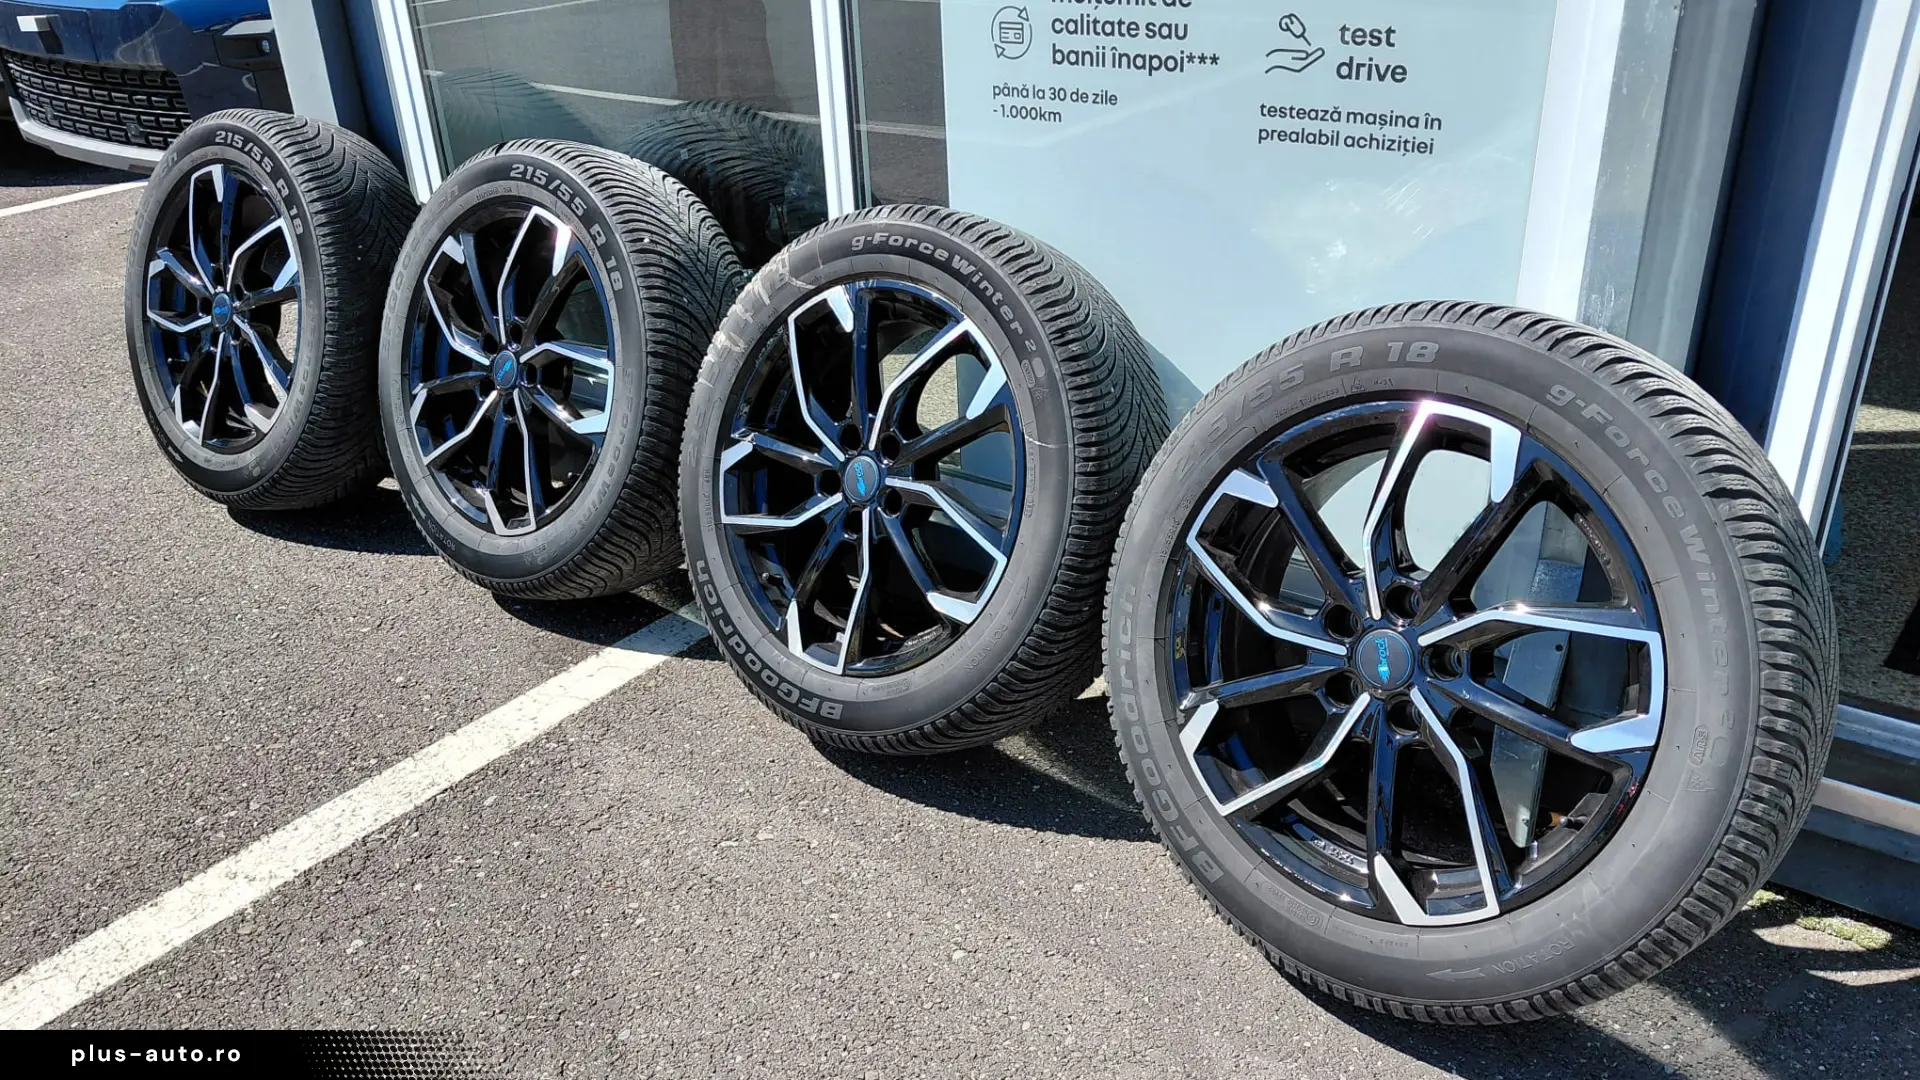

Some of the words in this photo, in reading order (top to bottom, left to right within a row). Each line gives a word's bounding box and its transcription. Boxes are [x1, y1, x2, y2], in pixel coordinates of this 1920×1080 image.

[1051, 13, 1140, 38] calitate
[1145, 23, 1188, 40] sau
[1338, 23, 1396, 48] test
[1052, 43, 1106, 68] banii
[1336, 56, 1408, 83] drive
[993, 82, 1029, 99] până
[1033, 84, 1045, 100] la
[1048, 87, 1067, 101] 30
[1070, 88, 1089, 103] de
[1092, 89, 1118, 105] zile
[1259, 102, 1342, 123] testează
[1346, 110, 1419, 131] mașina
[1424, 112, 1442, 130] în
[1258, 127, 1340, 147] prealabil
[1343, 133, 1434, 157] achiziției
[214, 130, 274, 174] 215/55
[275, 178, 289, 199] R
[288, 204, 304, 235] 18
[509, 163, 588, 217] 215/55
[589, 223, 607, 247] R
[605, 256, 624, 291] 18
[1329, 346, 1364, 372] R
[1387, 341, 1439, 363] 18
[696, 560, 844, 720] BFGoodrich
[1118, 584, 1225, 883] BFGoodrich
[1491, 936, 1576, 975] ROTATION
